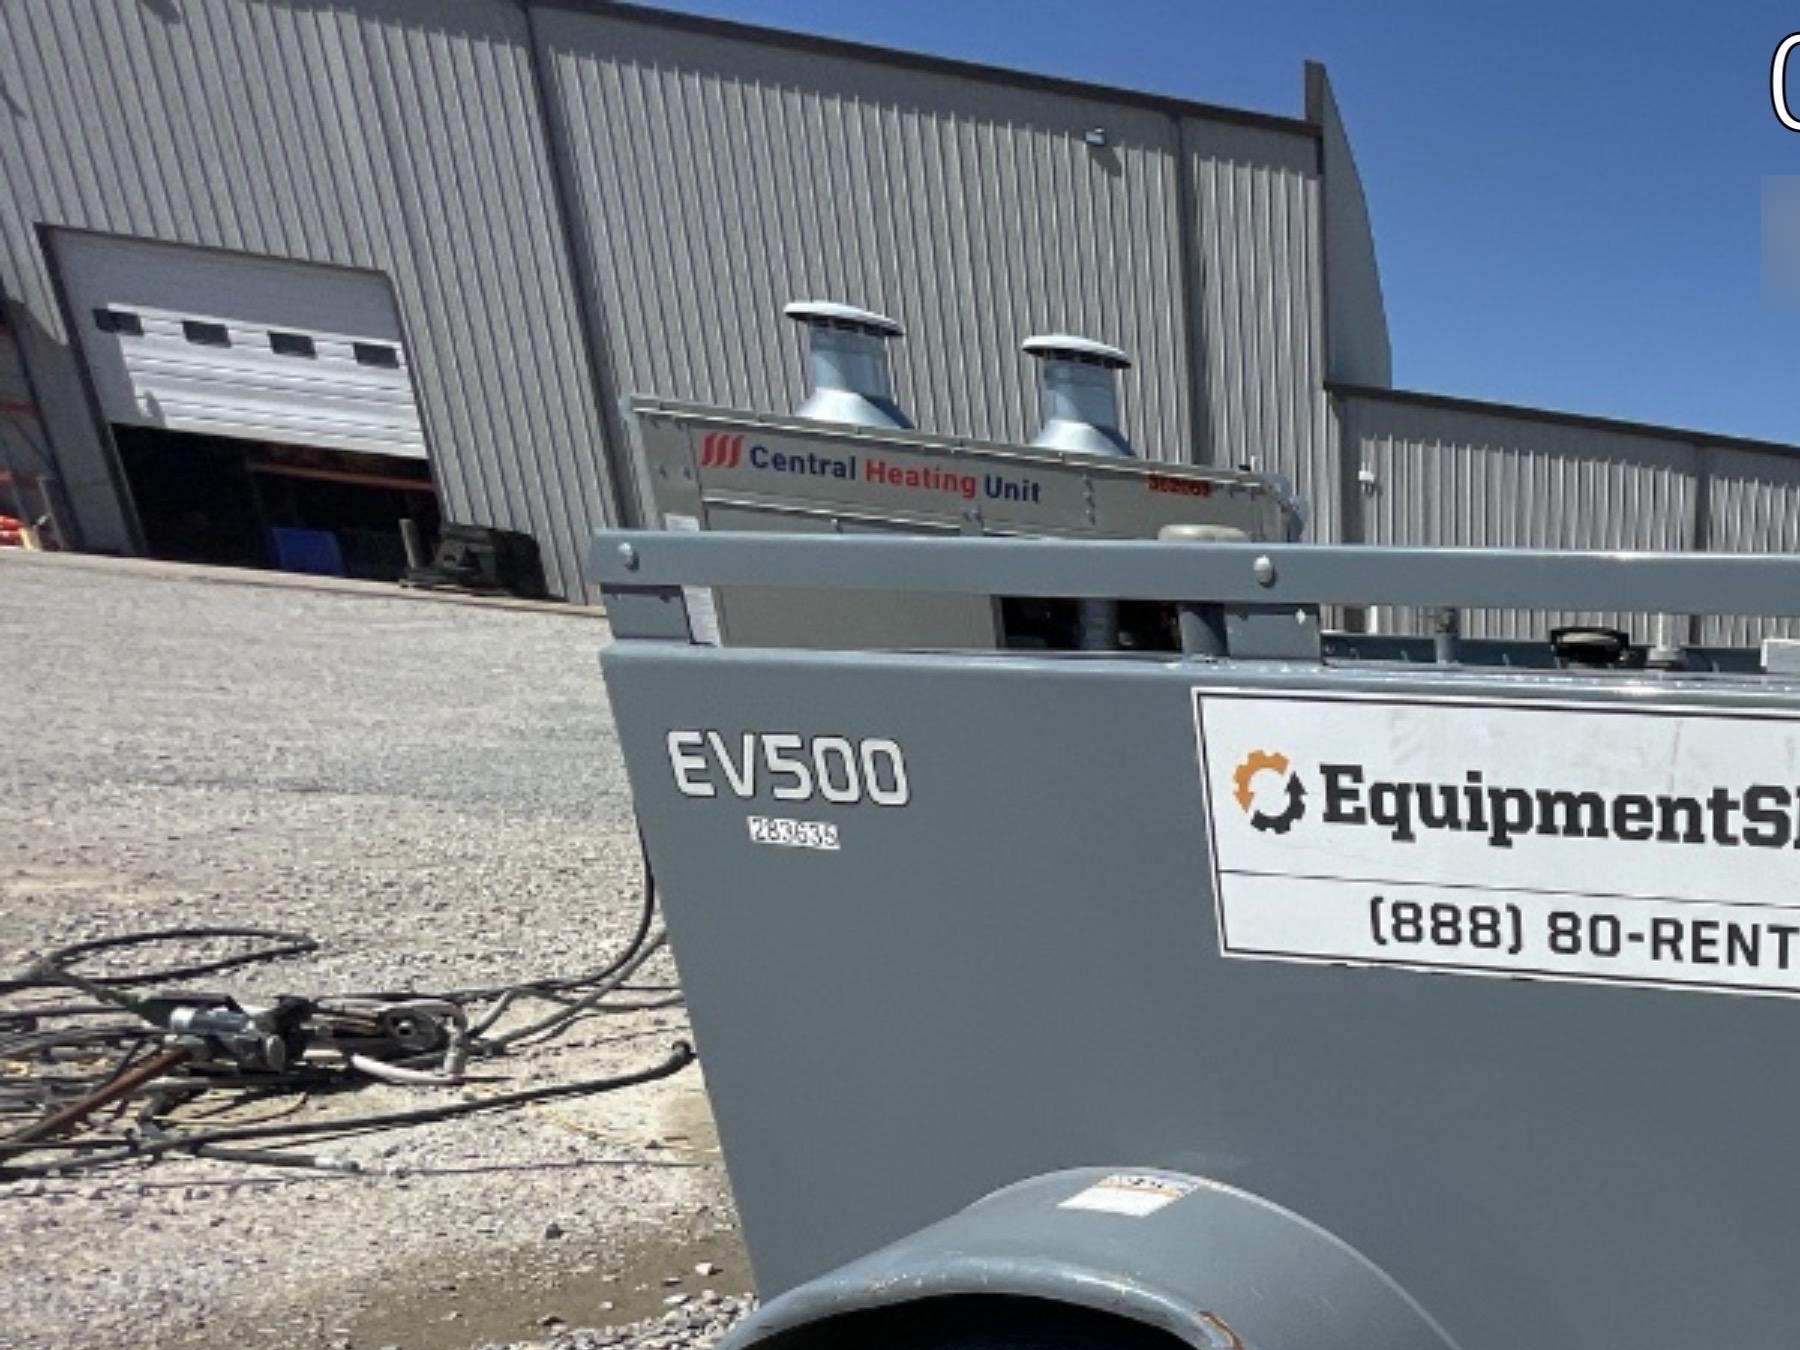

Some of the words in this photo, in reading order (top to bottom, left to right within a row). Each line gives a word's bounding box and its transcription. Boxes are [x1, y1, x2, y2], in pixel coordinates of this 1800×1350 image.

[750, 446, 857, 481] Central
[865, 459, 977, 499] Heating
[985, 473, 1041, 504] Unit
[667, 730, 910, 807] EV500
[1370, 896, 1523, 955] (888)
